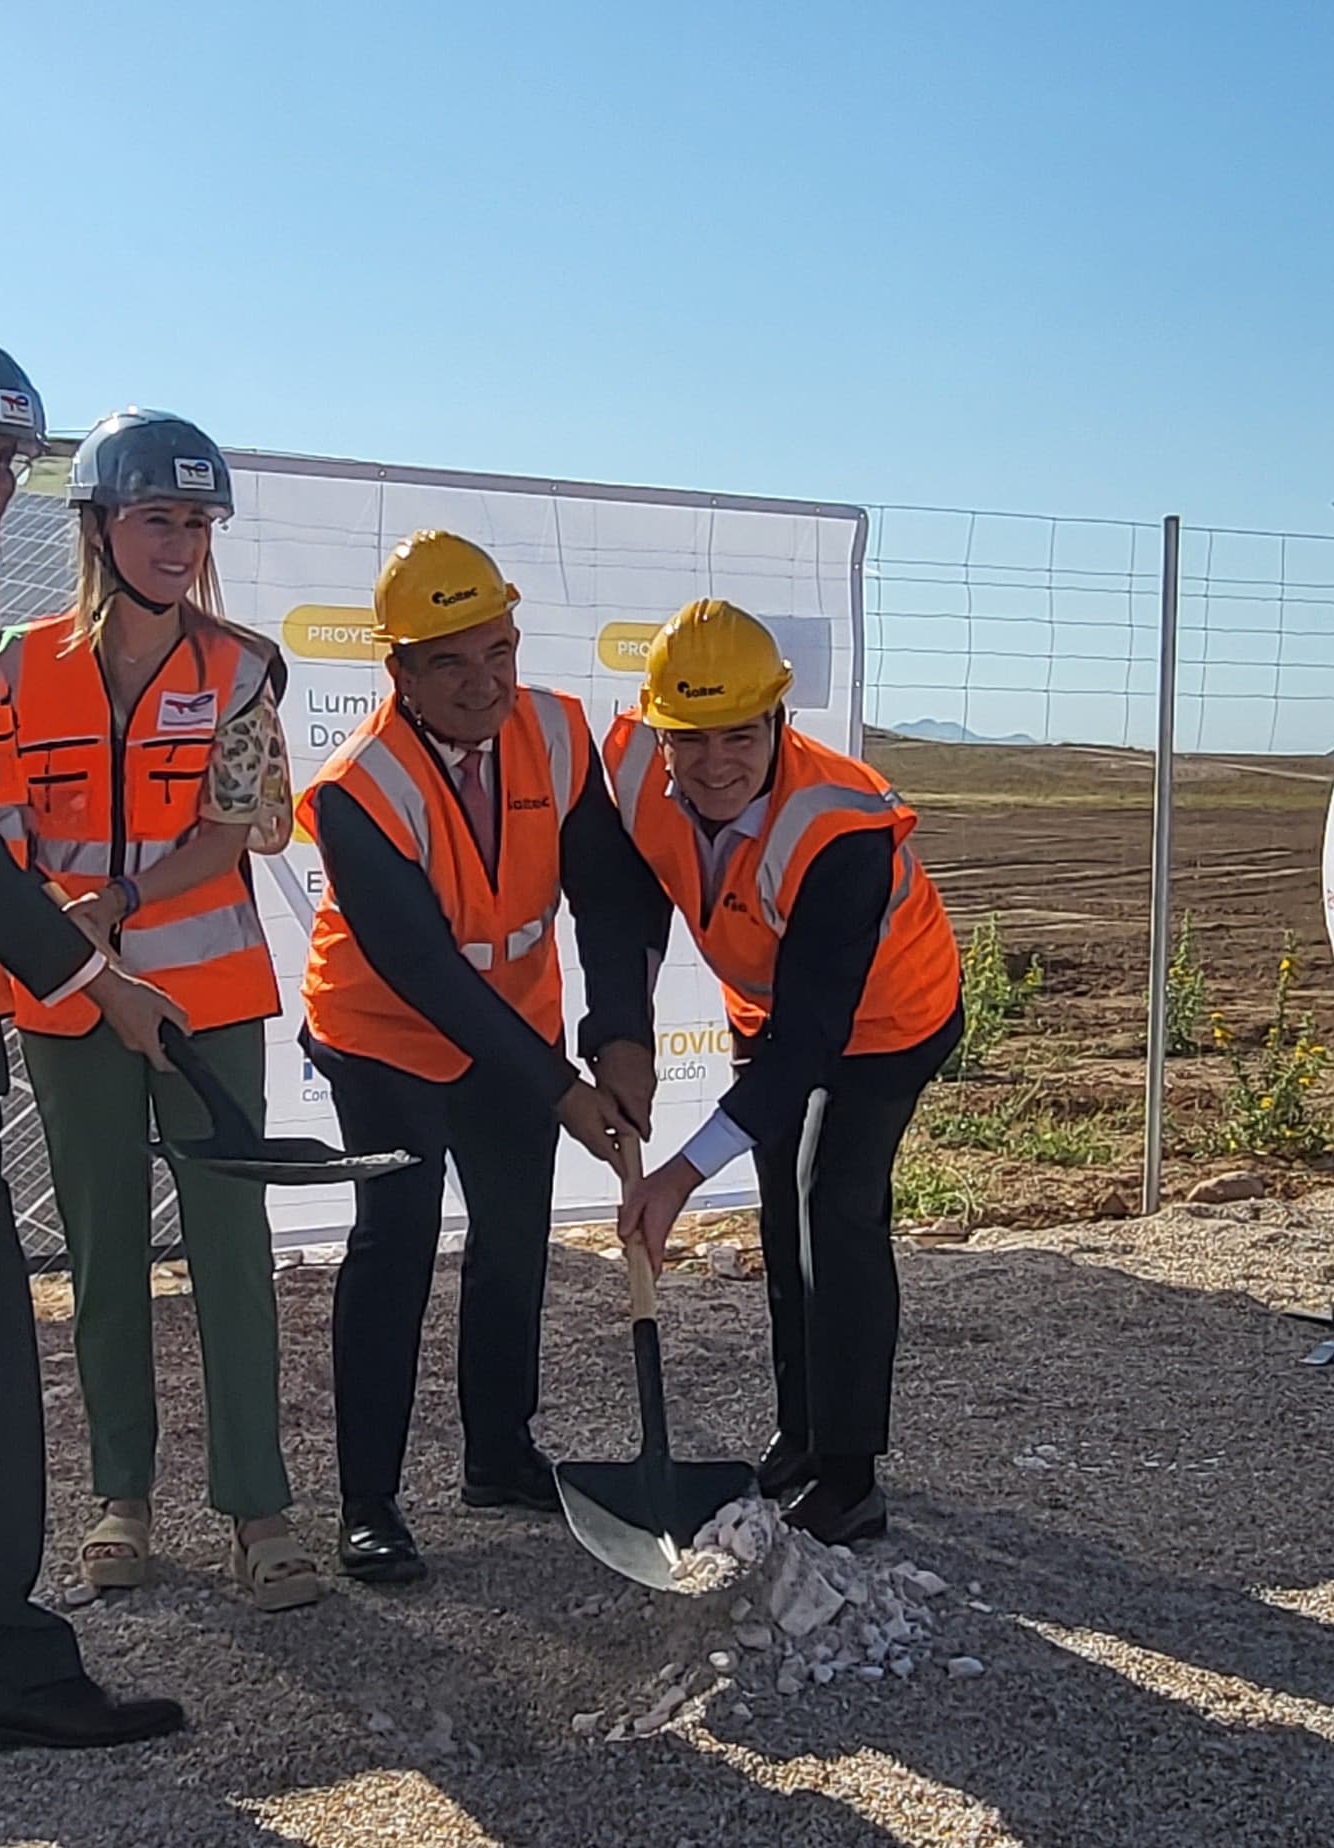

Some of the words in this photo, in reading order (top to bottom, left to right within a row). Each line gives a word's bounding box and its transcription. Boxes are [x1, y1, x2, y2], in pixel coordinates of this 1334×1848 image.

[307, 626, 373, 644] PROYE
[617, 640, 653, 658] PRO
[308, 689, 383, 715] Lumi
[310, 724, 351, 748] Do
[657, 1061, 706, 1081] ucción
[302, 1089, 329, 1102] Con
